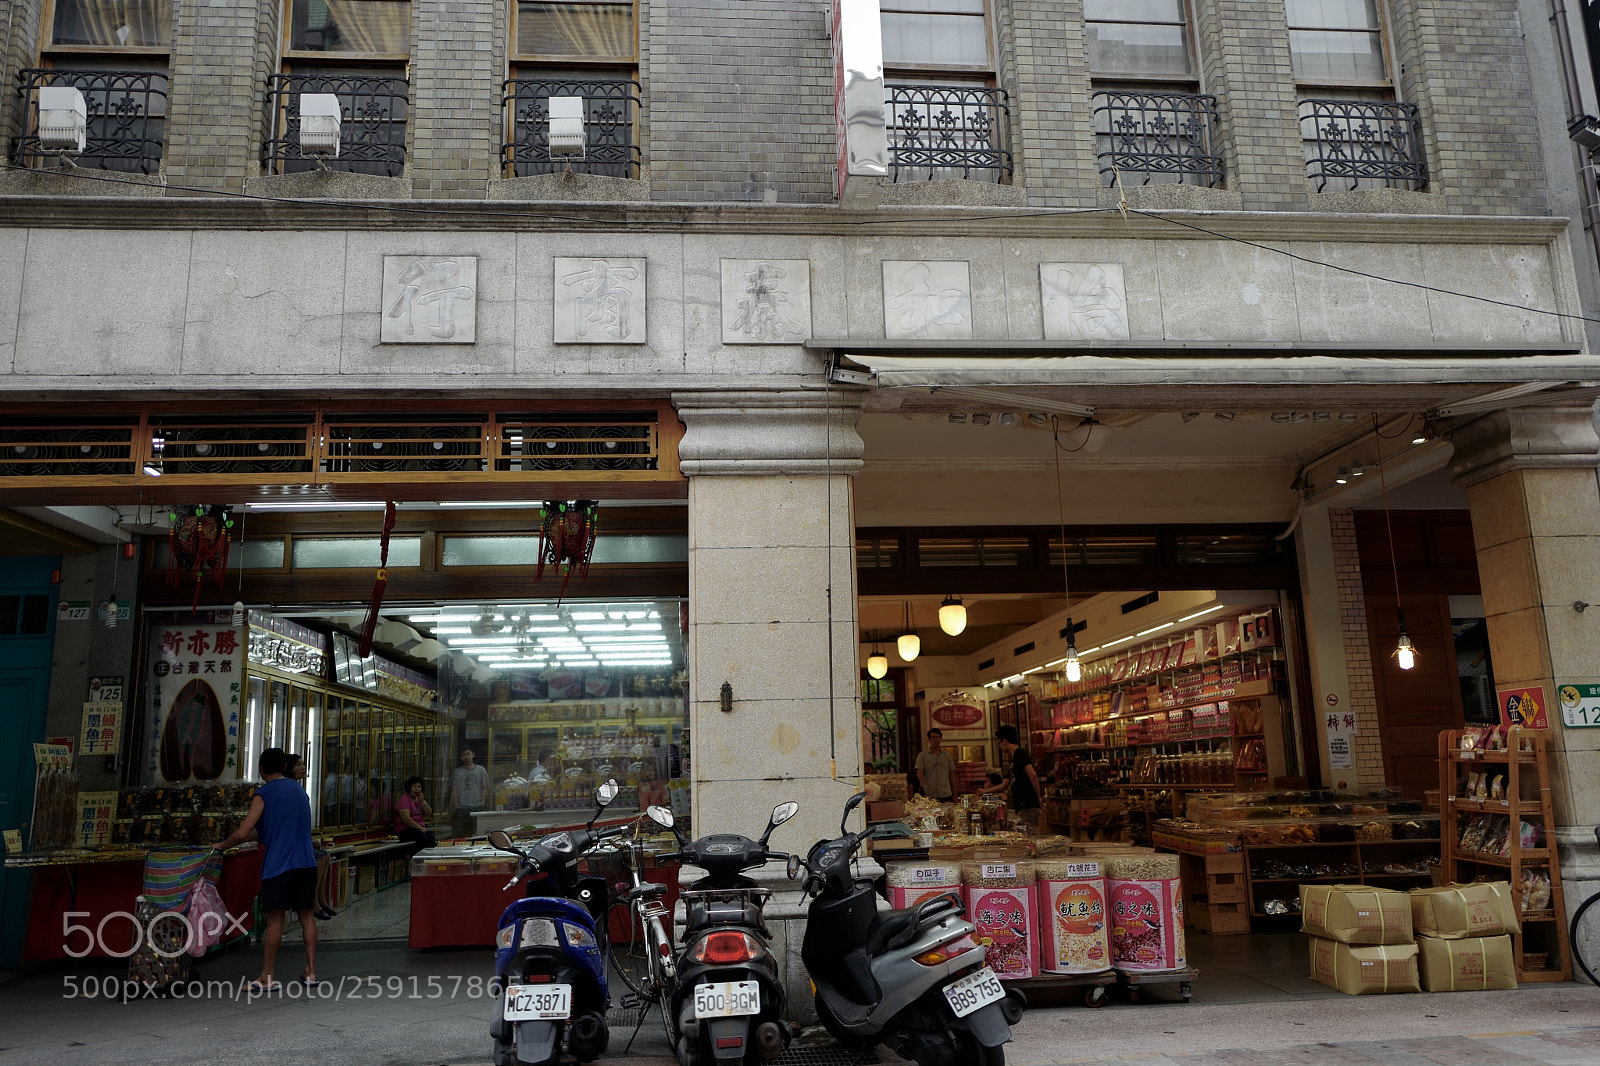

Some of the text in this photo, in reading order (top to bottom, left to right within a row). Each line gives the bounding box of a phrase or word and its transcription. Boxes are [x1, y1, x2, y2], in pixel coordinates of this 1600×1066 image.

[69, 609, 86, 618] 127
[99, 688, 121, 700] 125
[1327, 714, 1356, 731] 柿餅
[980, 908, 1023, 924] 海之味
[1114, 901, 1156, 917] 海之味
